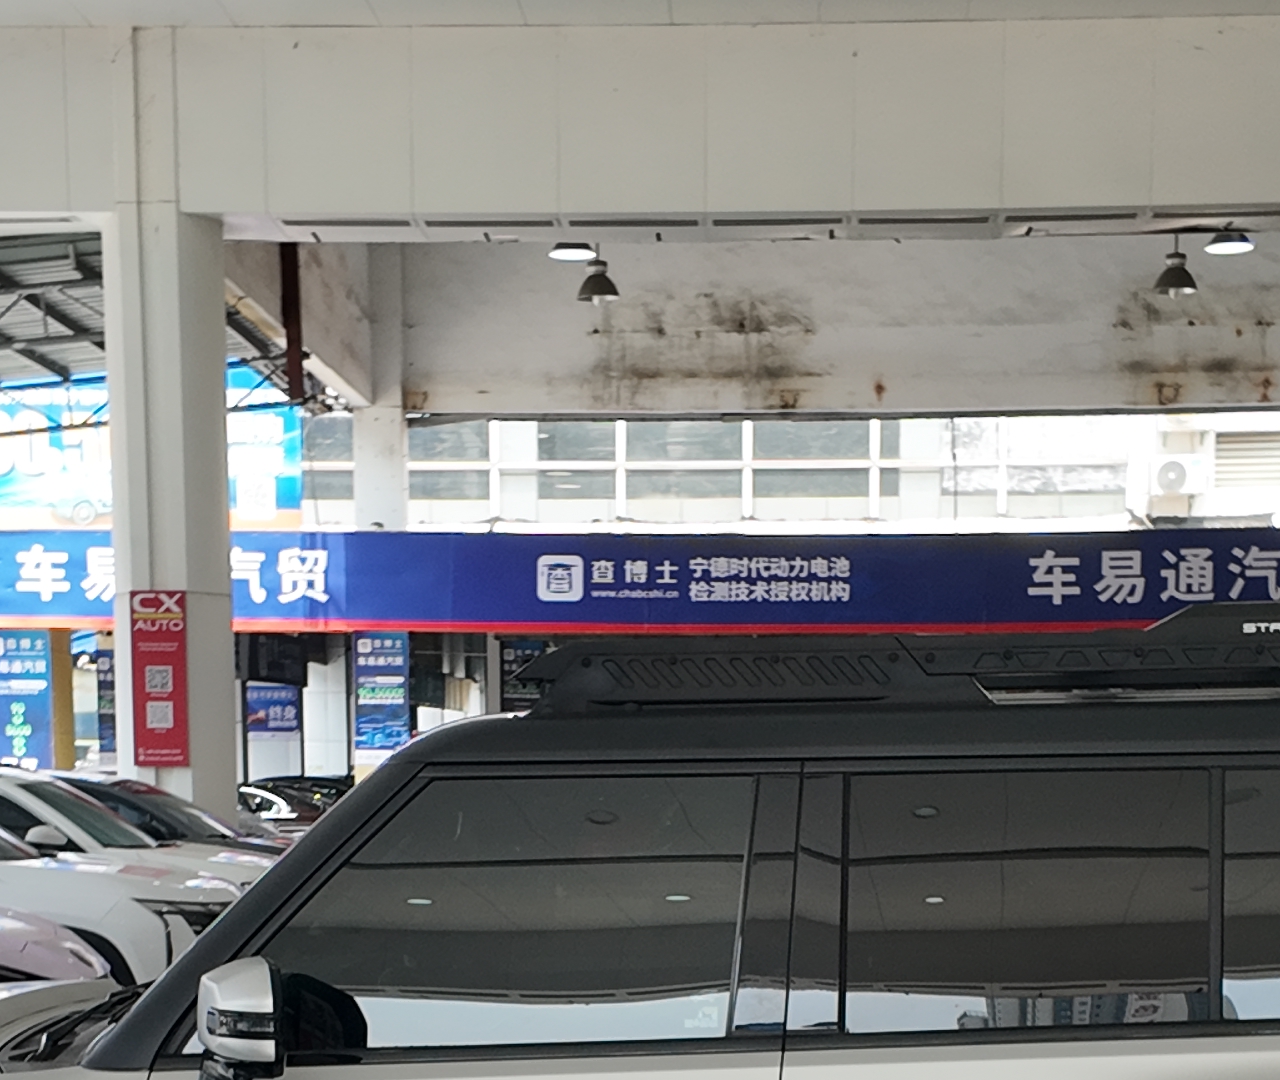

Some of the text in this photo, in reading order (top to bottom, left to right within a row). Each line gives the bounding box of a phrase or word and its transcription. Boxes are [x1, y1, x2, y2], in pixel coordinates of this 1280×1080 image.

[590, 557, 851, 584] 查博士 宁德时代动力电池
[689, 581, 851, 602] 检测技术授权机构
[133, 593, 183, 613] CX
[133, 619, 184, 632] AUTO
